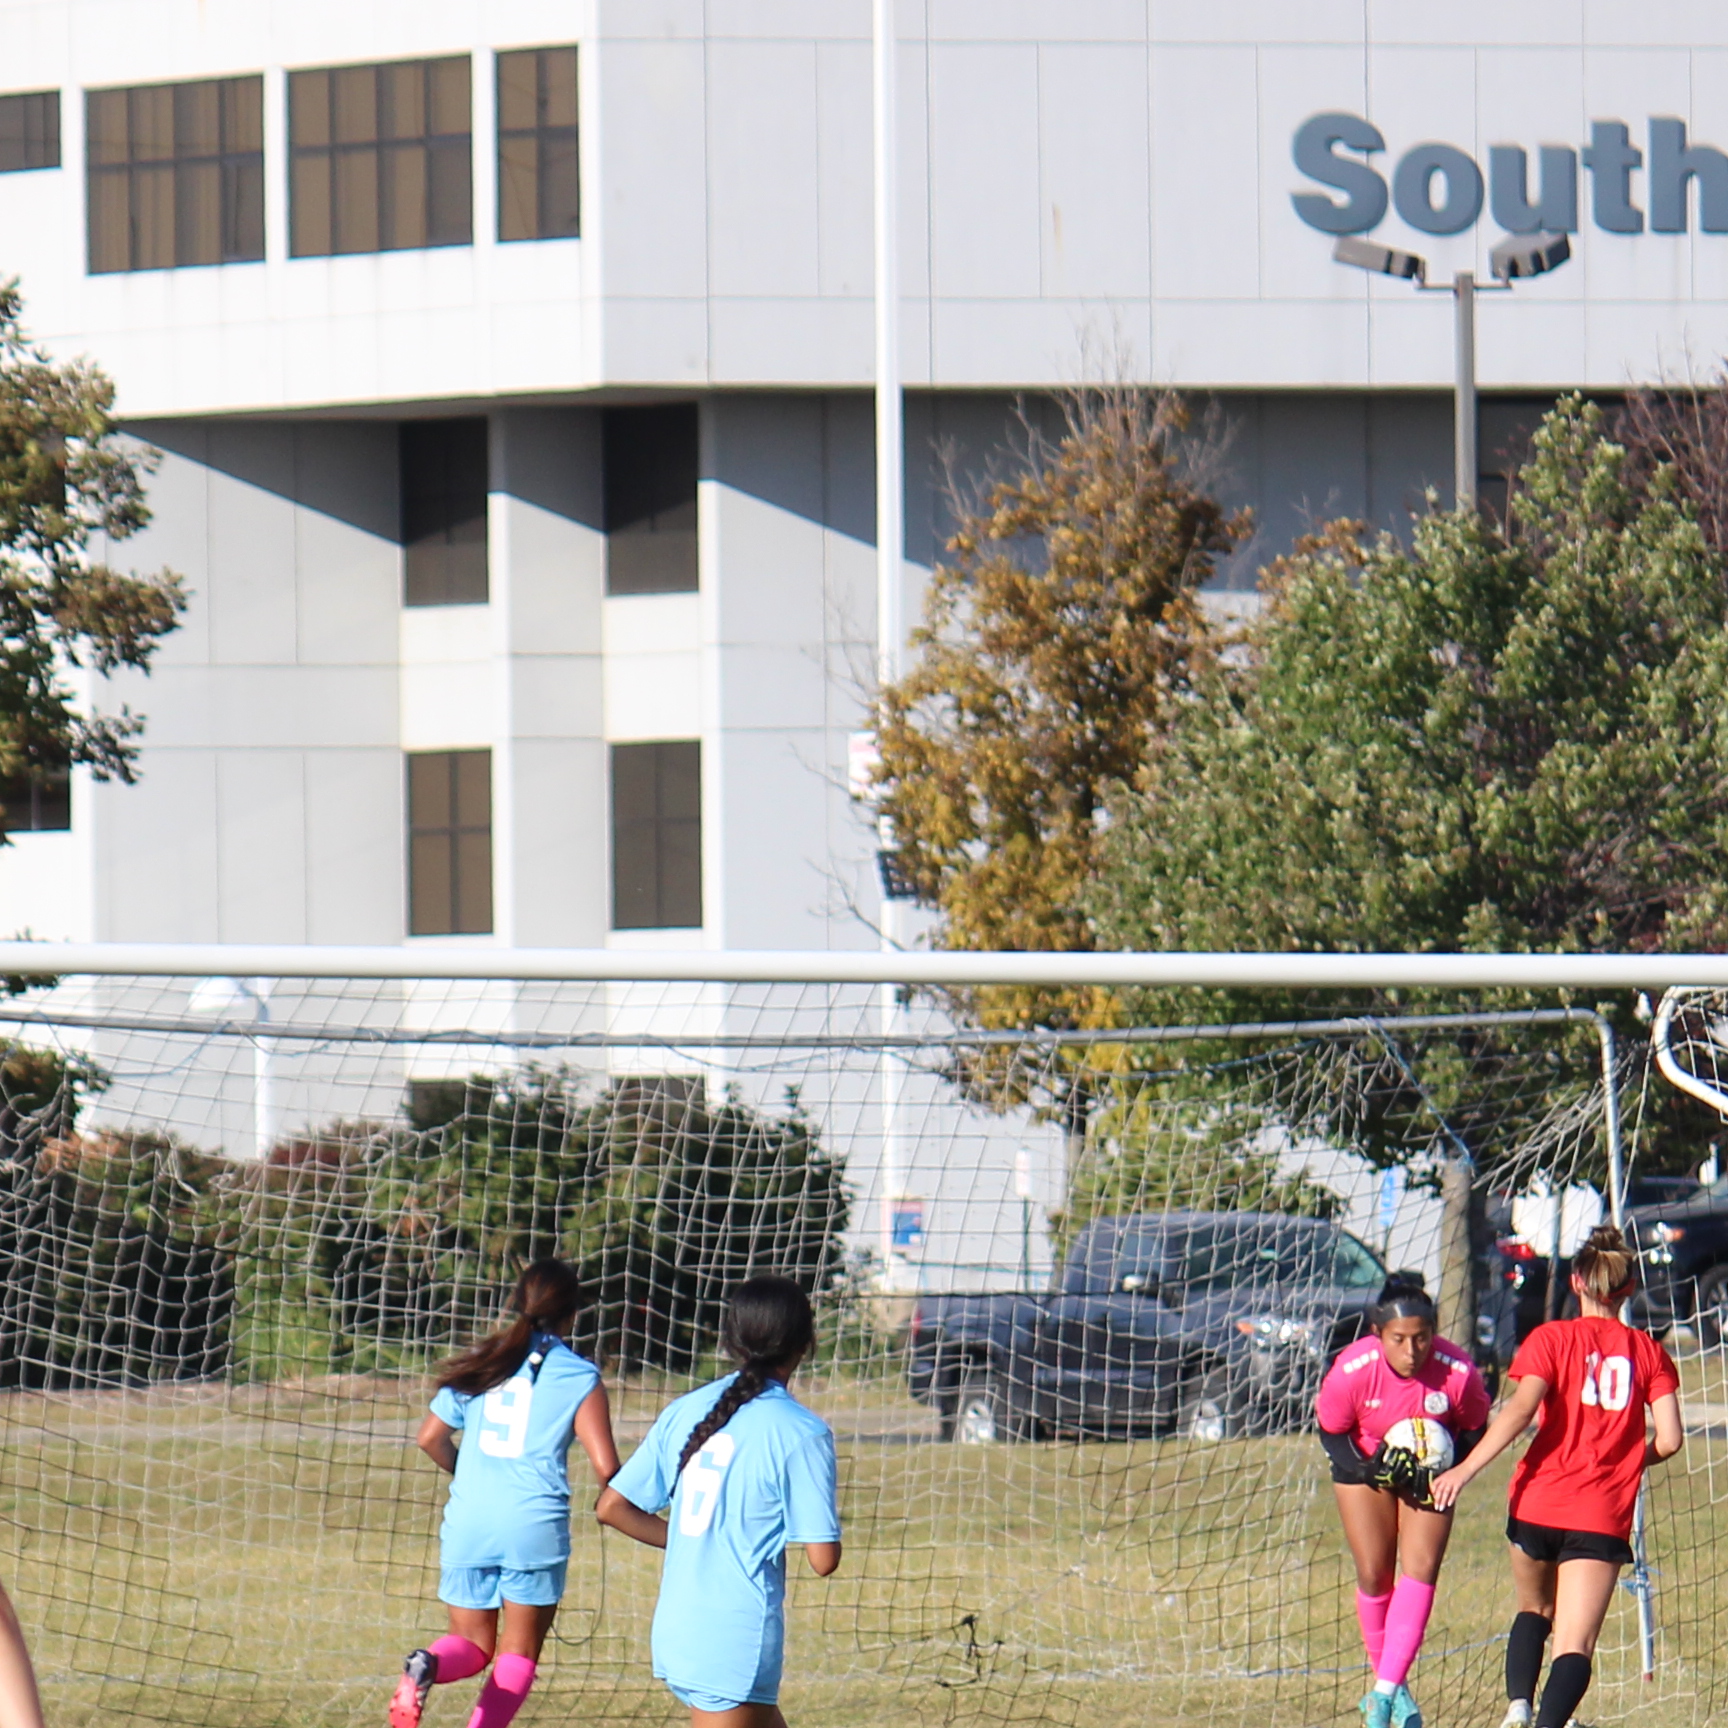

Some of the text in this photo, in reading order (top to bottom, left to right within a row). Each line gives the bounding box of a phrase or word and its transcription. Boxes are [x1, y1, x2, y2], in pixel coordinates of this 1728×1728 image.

[478, 1376, 533, 1459] 9
[1581, 1351, 1632, 1411] 10
[679, 1433, 735, 1537] 6
